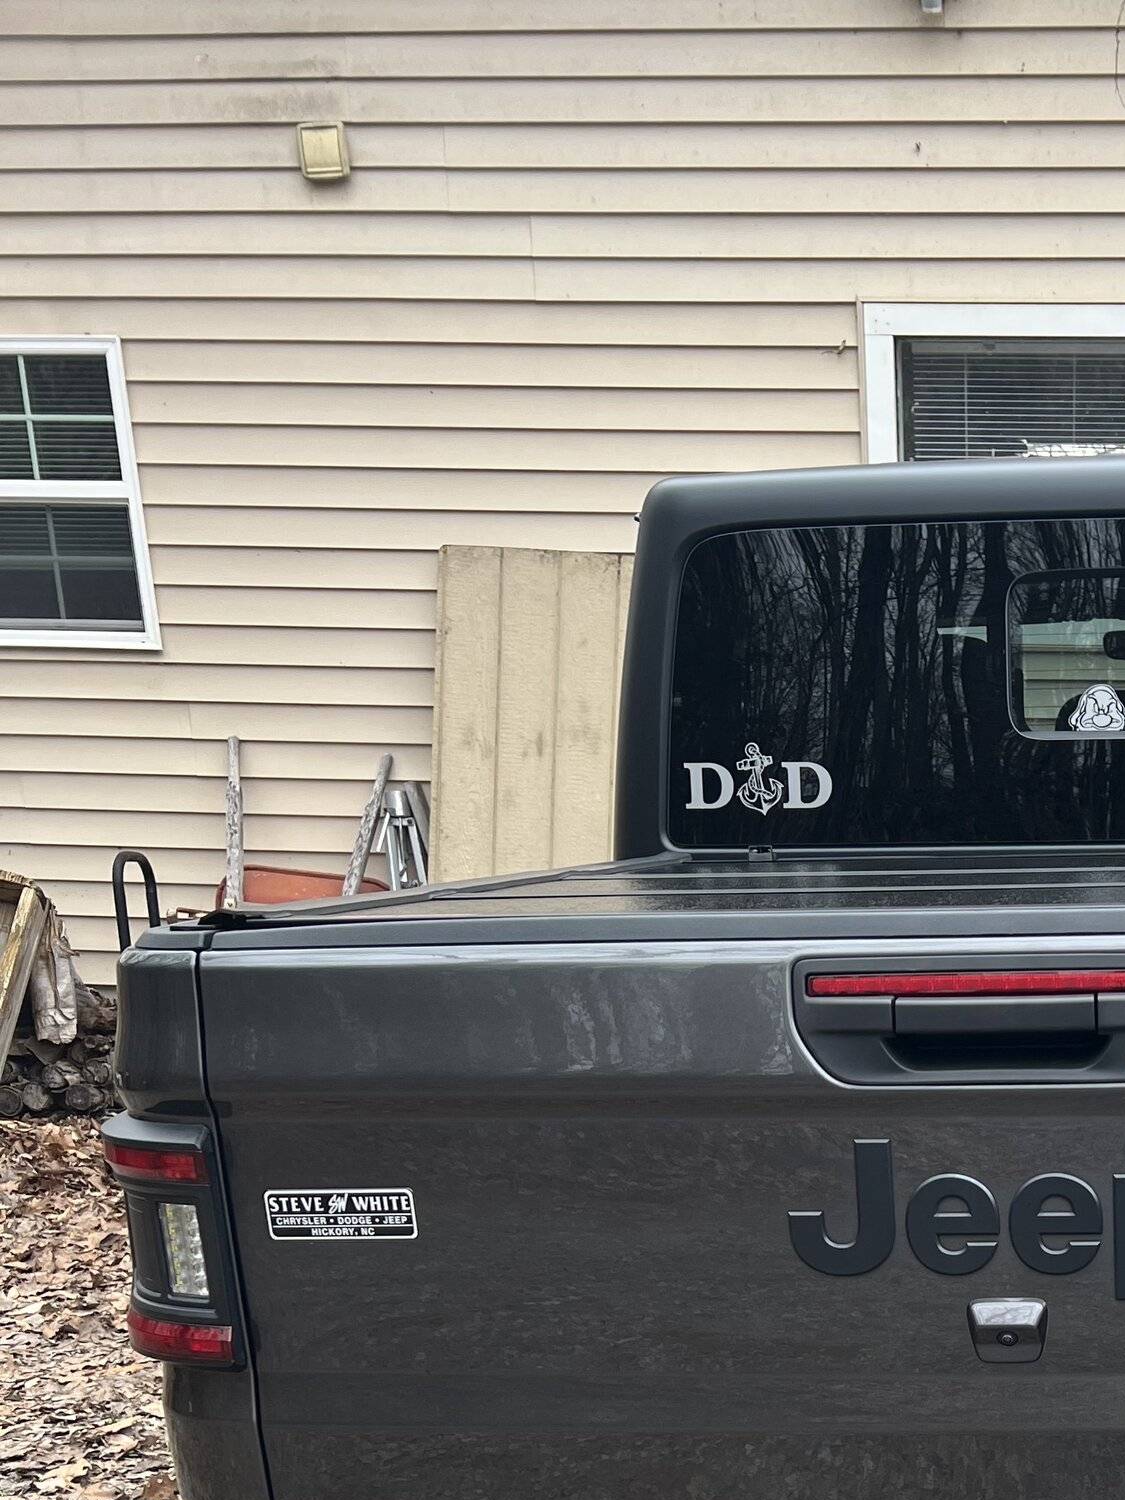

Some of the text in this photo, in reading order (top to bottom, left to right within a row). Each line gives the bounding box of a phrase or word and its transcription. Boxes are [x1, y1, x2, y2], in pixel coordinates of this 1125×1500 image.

[268, 1197, 324, 1212] STEVE
[352, 1196, 411, 1211] WHITE
[276, 1216, 408, 1225] CHRYSLER DODGE JEEP
[311, 1227, 375, 1236] HICKORY, NC
